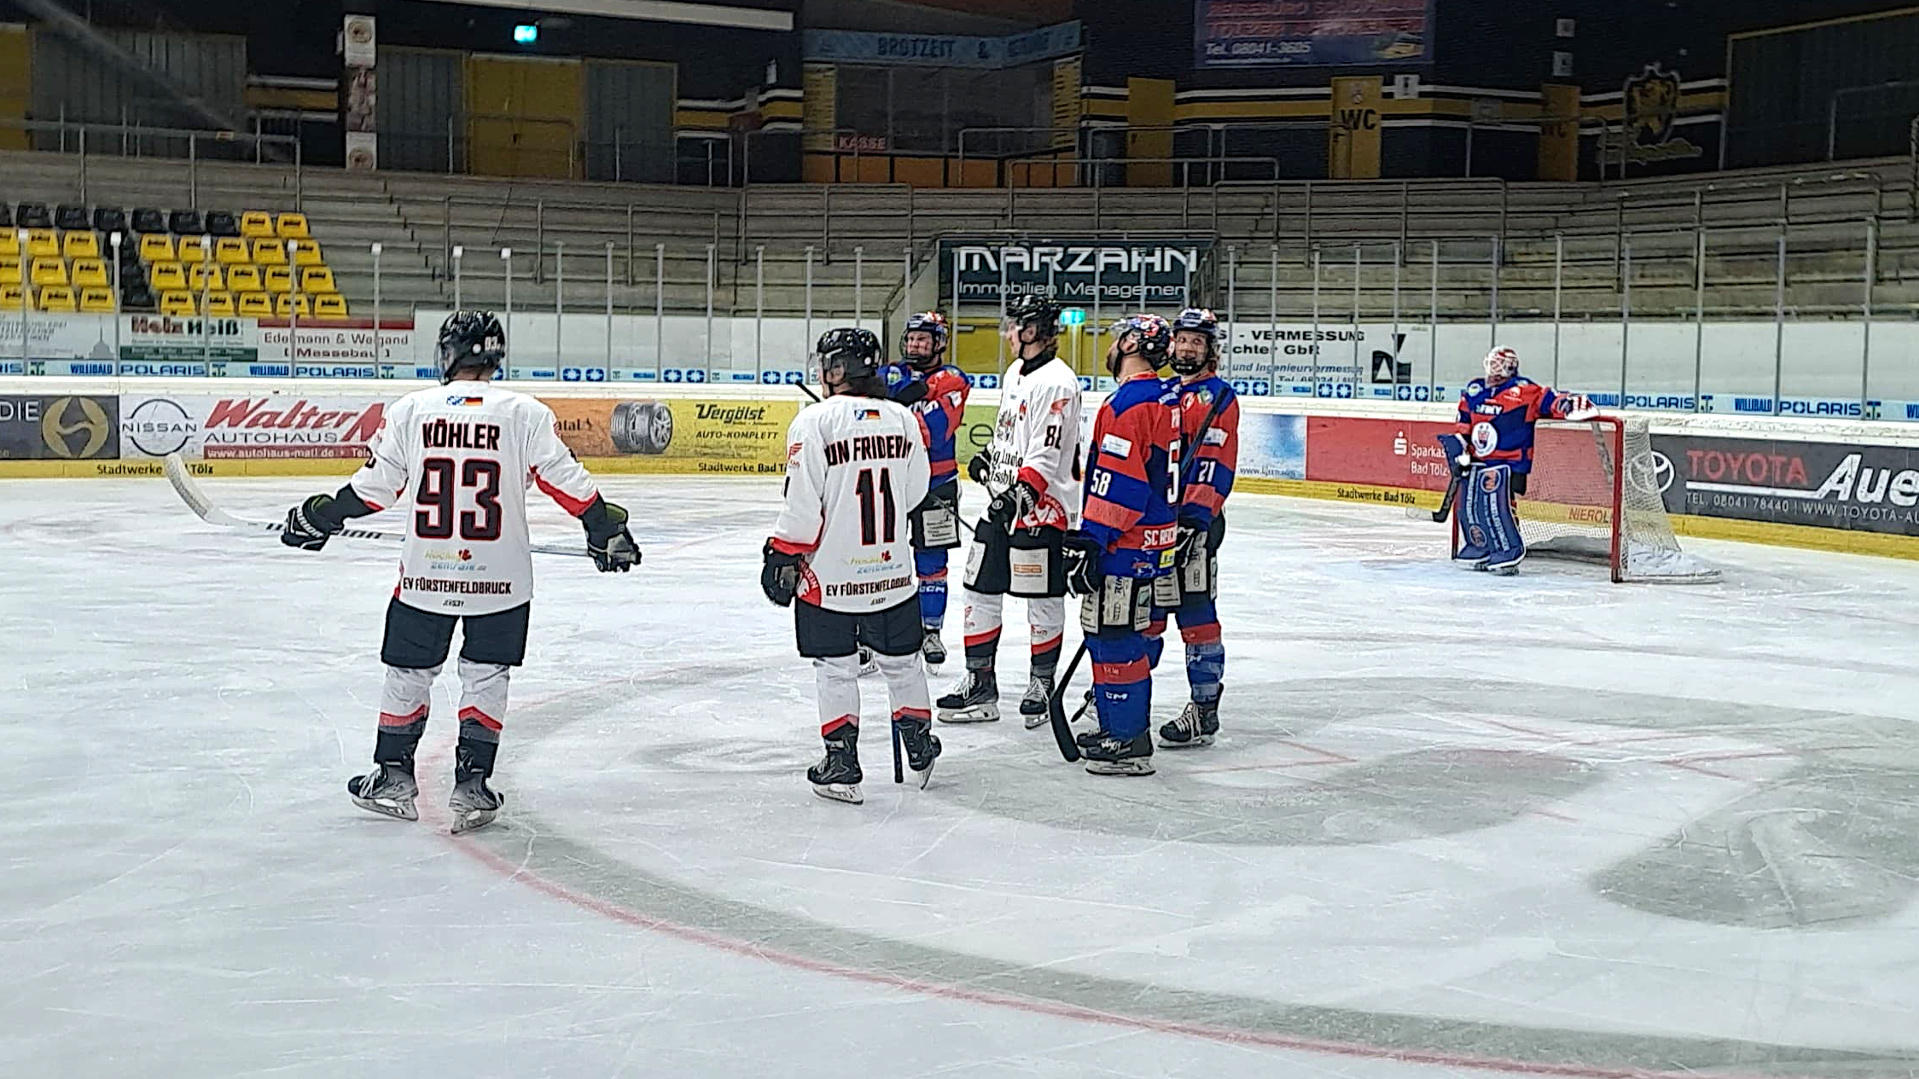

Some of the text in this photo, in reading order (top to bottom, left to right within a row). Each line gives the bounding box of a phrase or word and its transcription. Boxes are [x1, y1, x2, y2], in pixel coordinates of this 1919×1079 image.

[877, 37, 954, 58] BROTZEIT
[1341, 109, 1376, 130] WC
[838, 136, 887, 151] KASSE
[958, 246, 1198, 273] MARZAHN
[1064, 282, 1190, 299] Managemen
[351, 333, 409, 347] Wegand
[1251, 330, 1366, 341] VERMESSUNG
[1283, 344, 1321, 355] GbR
[120, 364, 205, 375] POLARIS
[295, 366, 375, 377] POLARIS
[1624, 395, 1695, 409] POLARIS
[1734, 398, 1862, 416] WILLIBALD POLARIS
[203, 398, 359, 429] Walter
[695, 403, 766, 424] Vergölst
[122, 422, 197, 433] NISSAN
[422, 418, 500, 451] KÖHLER
[695, 430, 779, 440] AUTO-KOMPLETT
[204, 431, 337, 444] AUTOHAUS
[96, 463, 163, 475] Stadtwerke
[191, 463, 214, 475] Tölz
[698, 462, 755, 473] Stadtwerke
[757, 463, 776, 473] Bad
[1166, 438, 1182, 505] 5
[1197, 460, 1217, 483] 21
[1411, 461, 1428, 474] Bad
[1686, 450, 1808, 486] TOYOTA
[1090, 469, 1112, 497] 58
[415, 456, 501, 541] 93
[1337, 488, 1415, 504] Stadtwerke Bad Tölz
[1686, 492, 1709, 506] TEL.
[1713, 495, 1749, 509] 08041
[1753, 497, 1789, 513] 78440
[856, 467, 895, 545] 11
[1144, 529, 1159, 546] SC
[402, 576, 512, 595] EV FÜRSTENFELDBRUCK
[826, 584, 839, 597] EV
